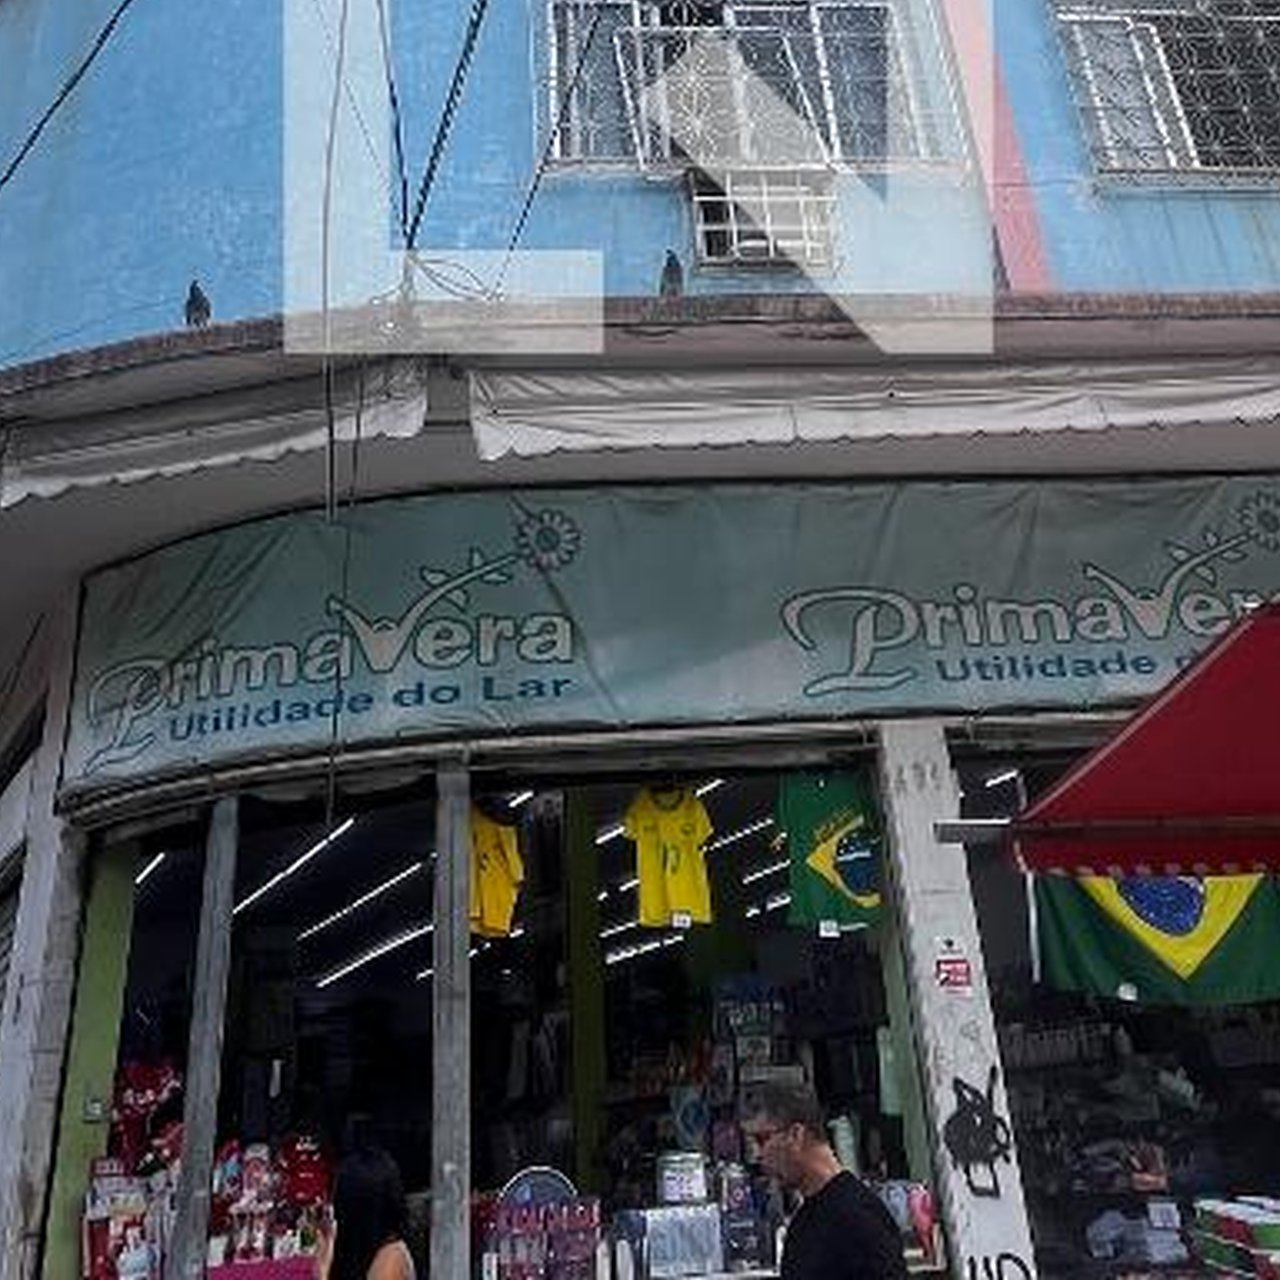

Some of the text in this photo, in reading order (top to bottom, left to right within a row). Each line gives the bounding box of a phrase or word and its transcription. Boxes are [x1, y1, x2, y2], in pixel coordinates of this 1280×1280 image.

[937, 650, 1155, 684] Utilidade
[168, 673, 572, 742] Utilidade do Lar
